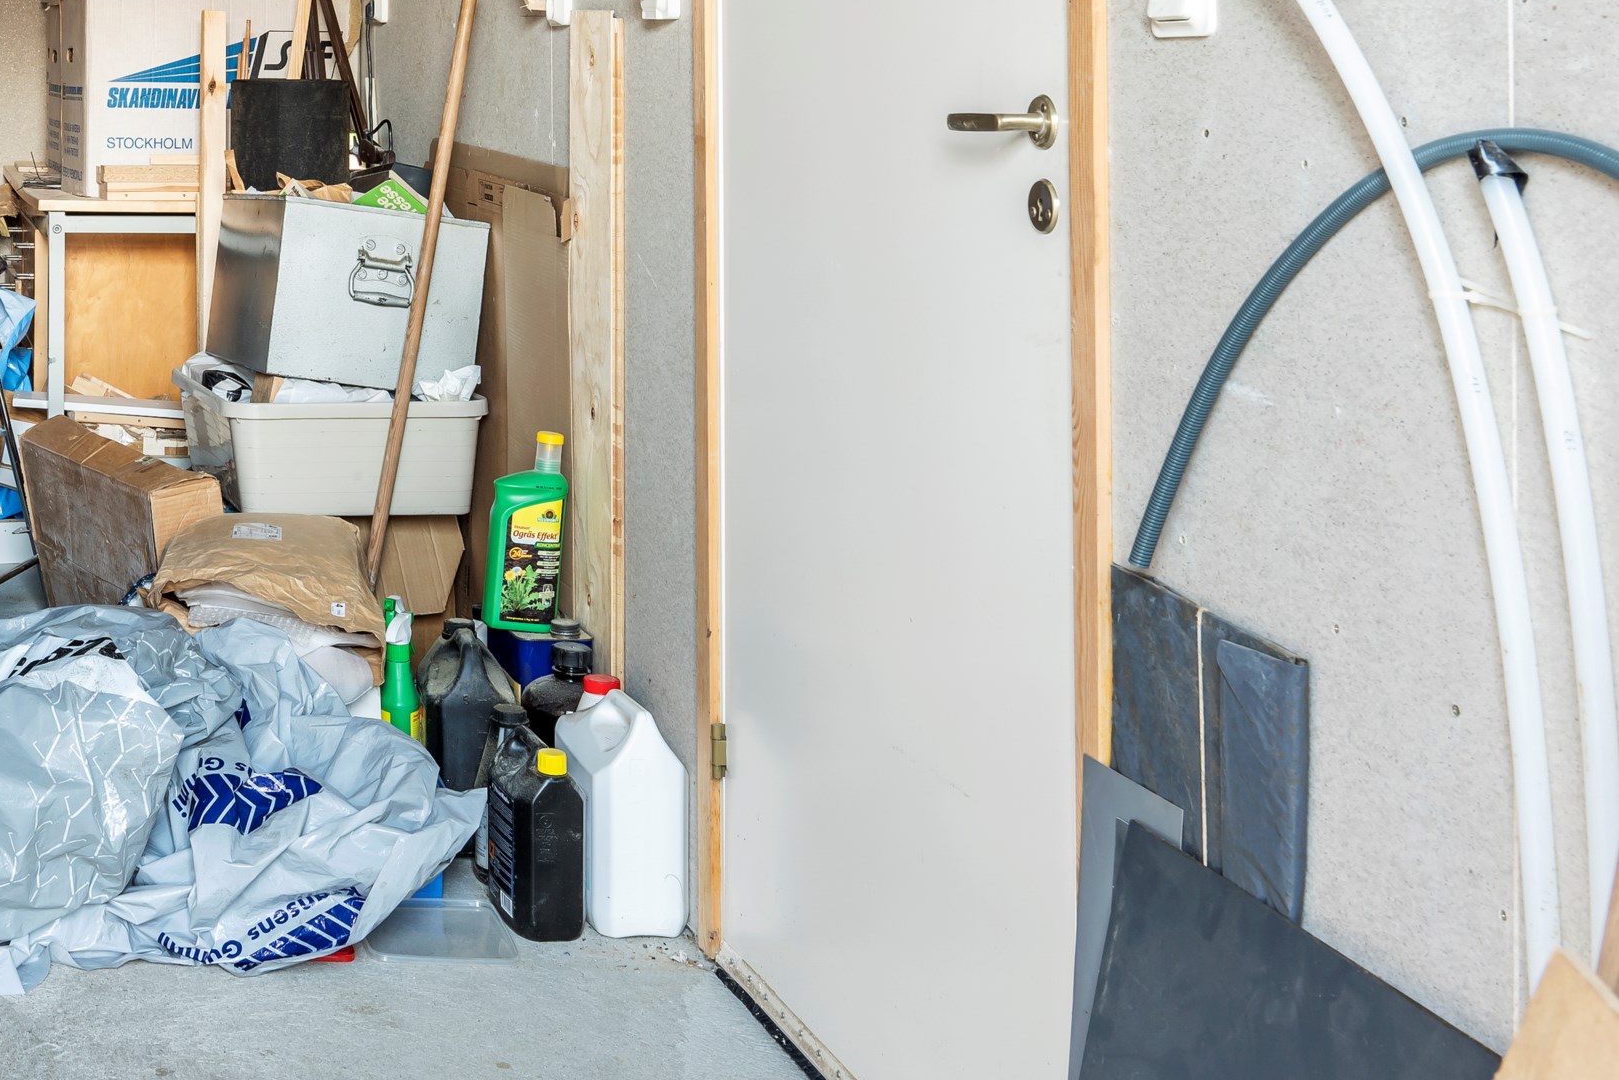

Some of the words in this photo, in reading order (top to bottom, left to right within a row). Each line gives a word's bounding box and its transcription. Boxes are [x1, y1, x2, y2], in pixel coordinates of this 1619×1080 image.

[264, 40, 334, 71] SF
[106, 137, 193, 150] STOCKHOLM
[513, 529, 536, 540] Ogräs
[536, 531, 559, 542] Effekt
